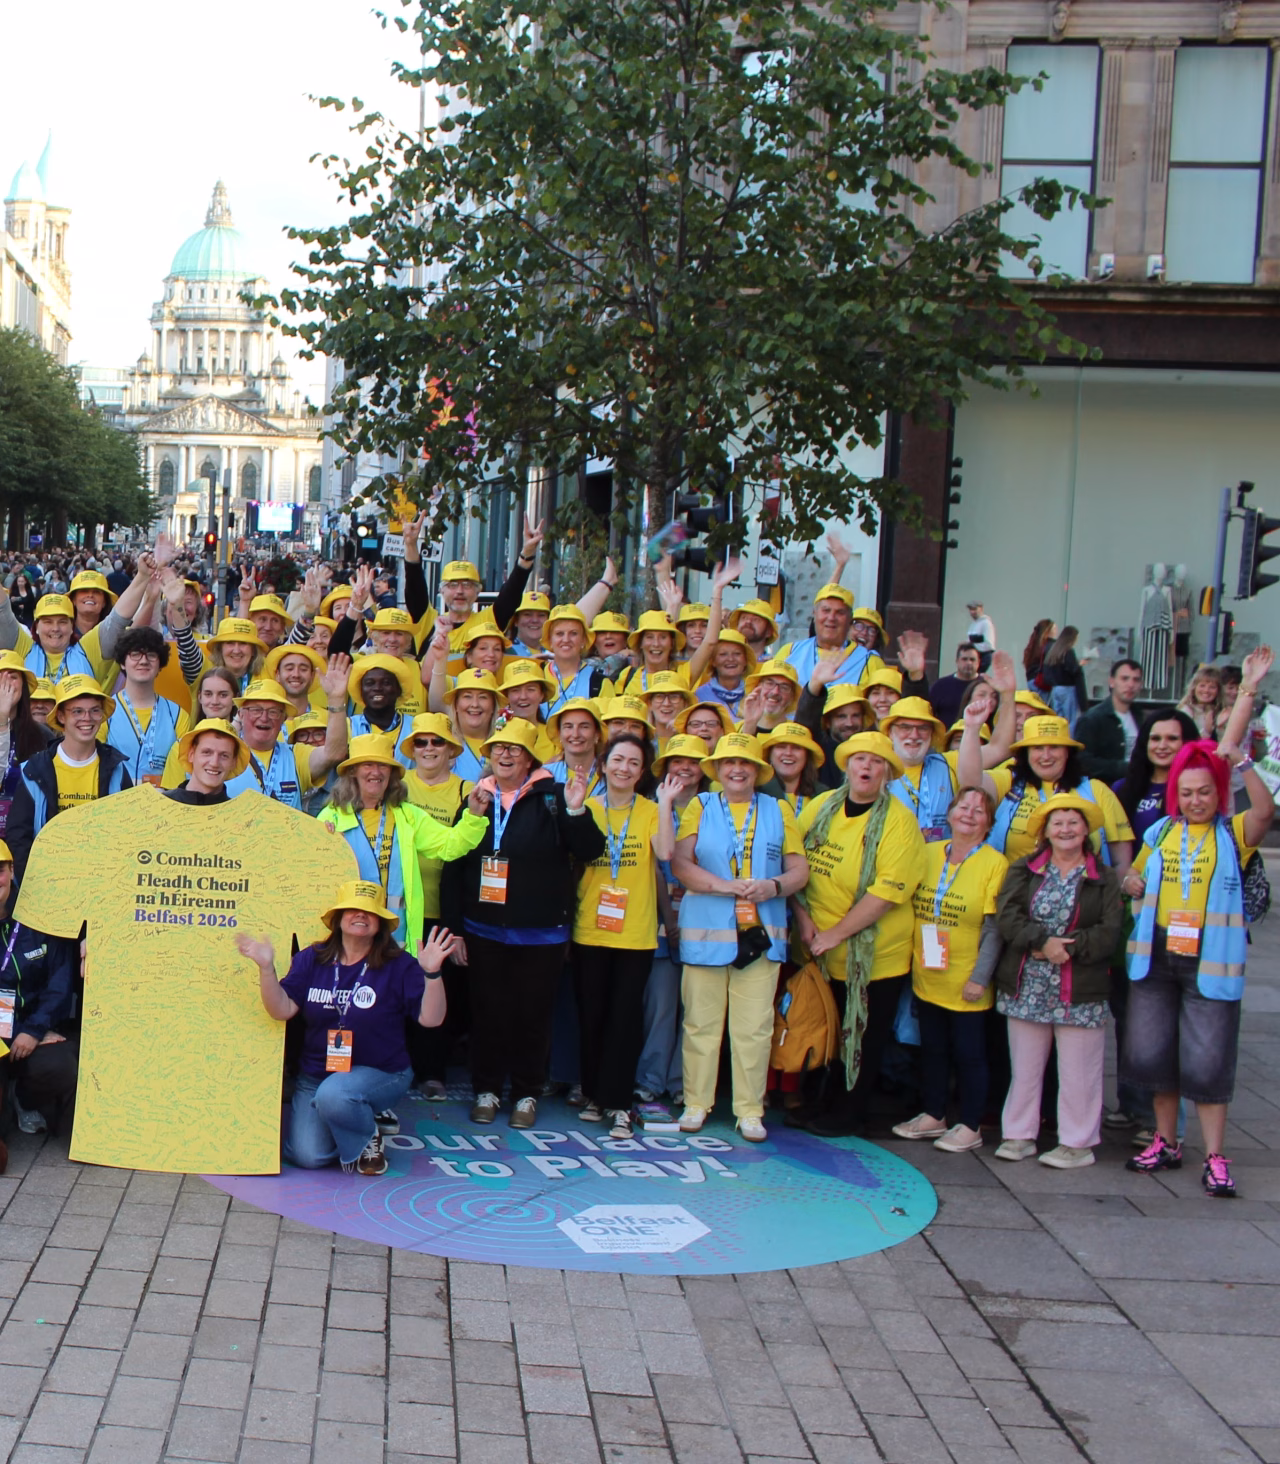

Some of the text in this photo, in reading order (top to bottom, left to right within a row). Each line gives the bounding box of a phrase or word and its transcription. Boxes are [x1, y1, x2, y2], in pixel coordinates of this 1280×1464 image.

[387, 537, 400, 545] Bus
[156, 852, 242, 870] Comhaltas
[136, 873, 249, 892] Fleadh Cheoil
[135, 889, 236, 909] na hÉireann
[134, 908, 238, 928] Belfast 2026
[937, 917, 959, 928] 2026
[355, 993, 373, 1004] NOW
[517, 1130, 734, 1152] Place
[428, 1155, 739, 1184] to Play!
[569, 1215, 691, 1226] Belfast
[580, 1226, 660, 1236] ONE
